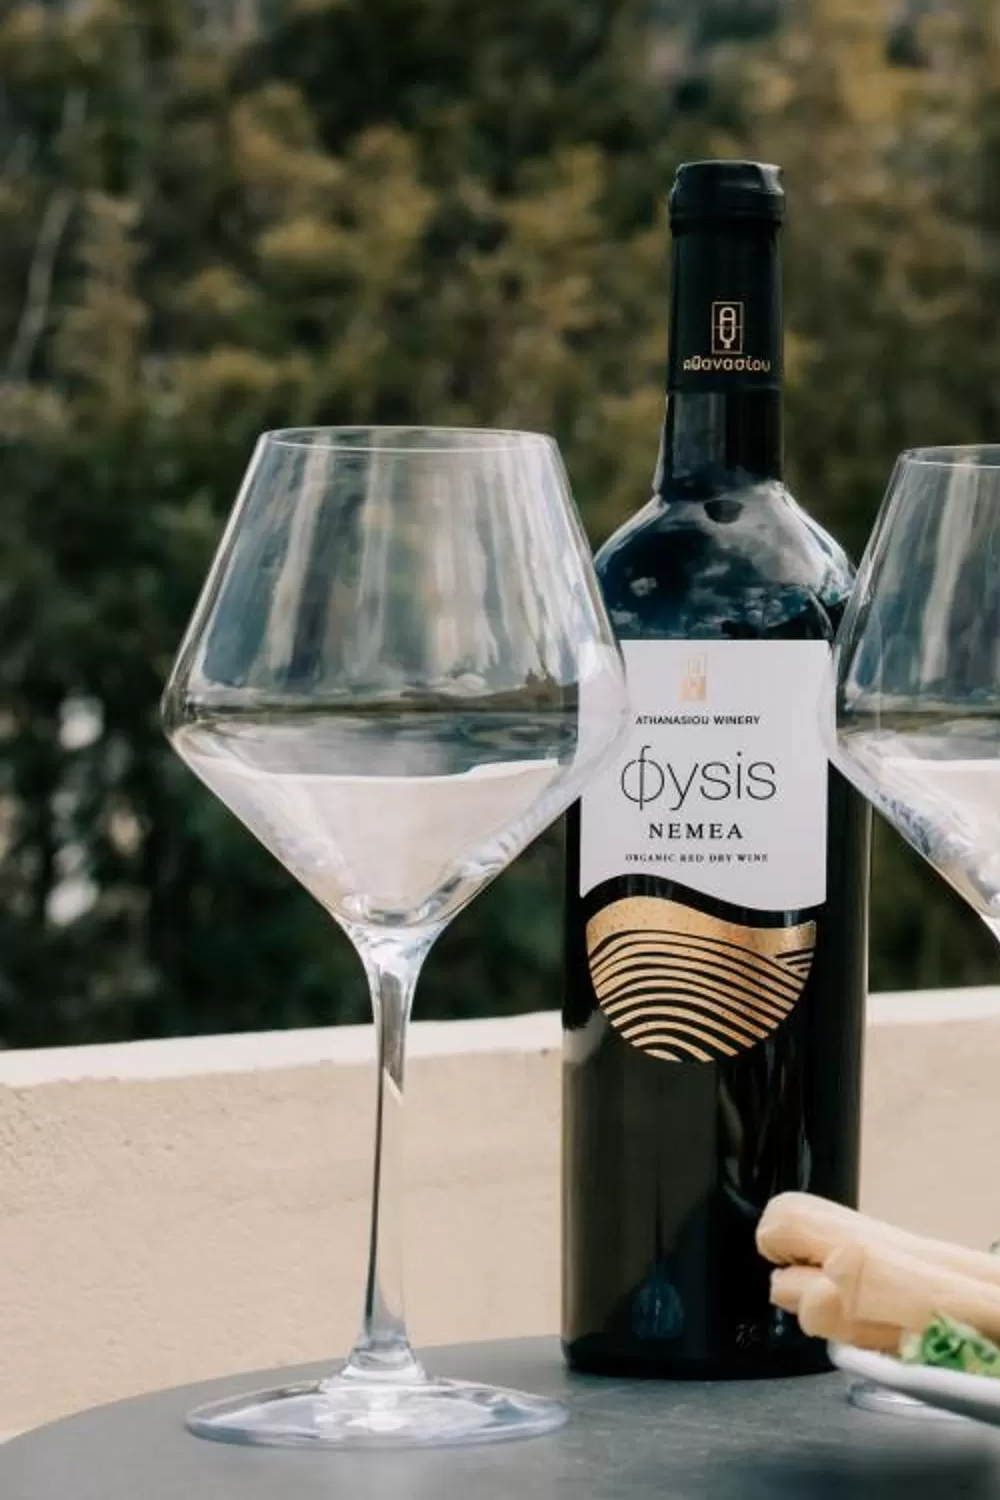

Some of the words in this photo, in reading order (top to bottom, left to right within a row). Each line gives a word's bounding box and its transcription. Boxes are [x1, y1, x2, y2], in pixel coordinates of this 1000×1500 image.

[635, 715, 709, 725] ATHANASIOU
[713, 715, 761, 725] WINERY
[649, 823, 744, 840] NEMEA
[625, 853, 676, 863] ORGANIC
[679, 853, 704, 863] RED
[709, 853, 732, 863] DRY
[736, 853, 769, 863] WINE
